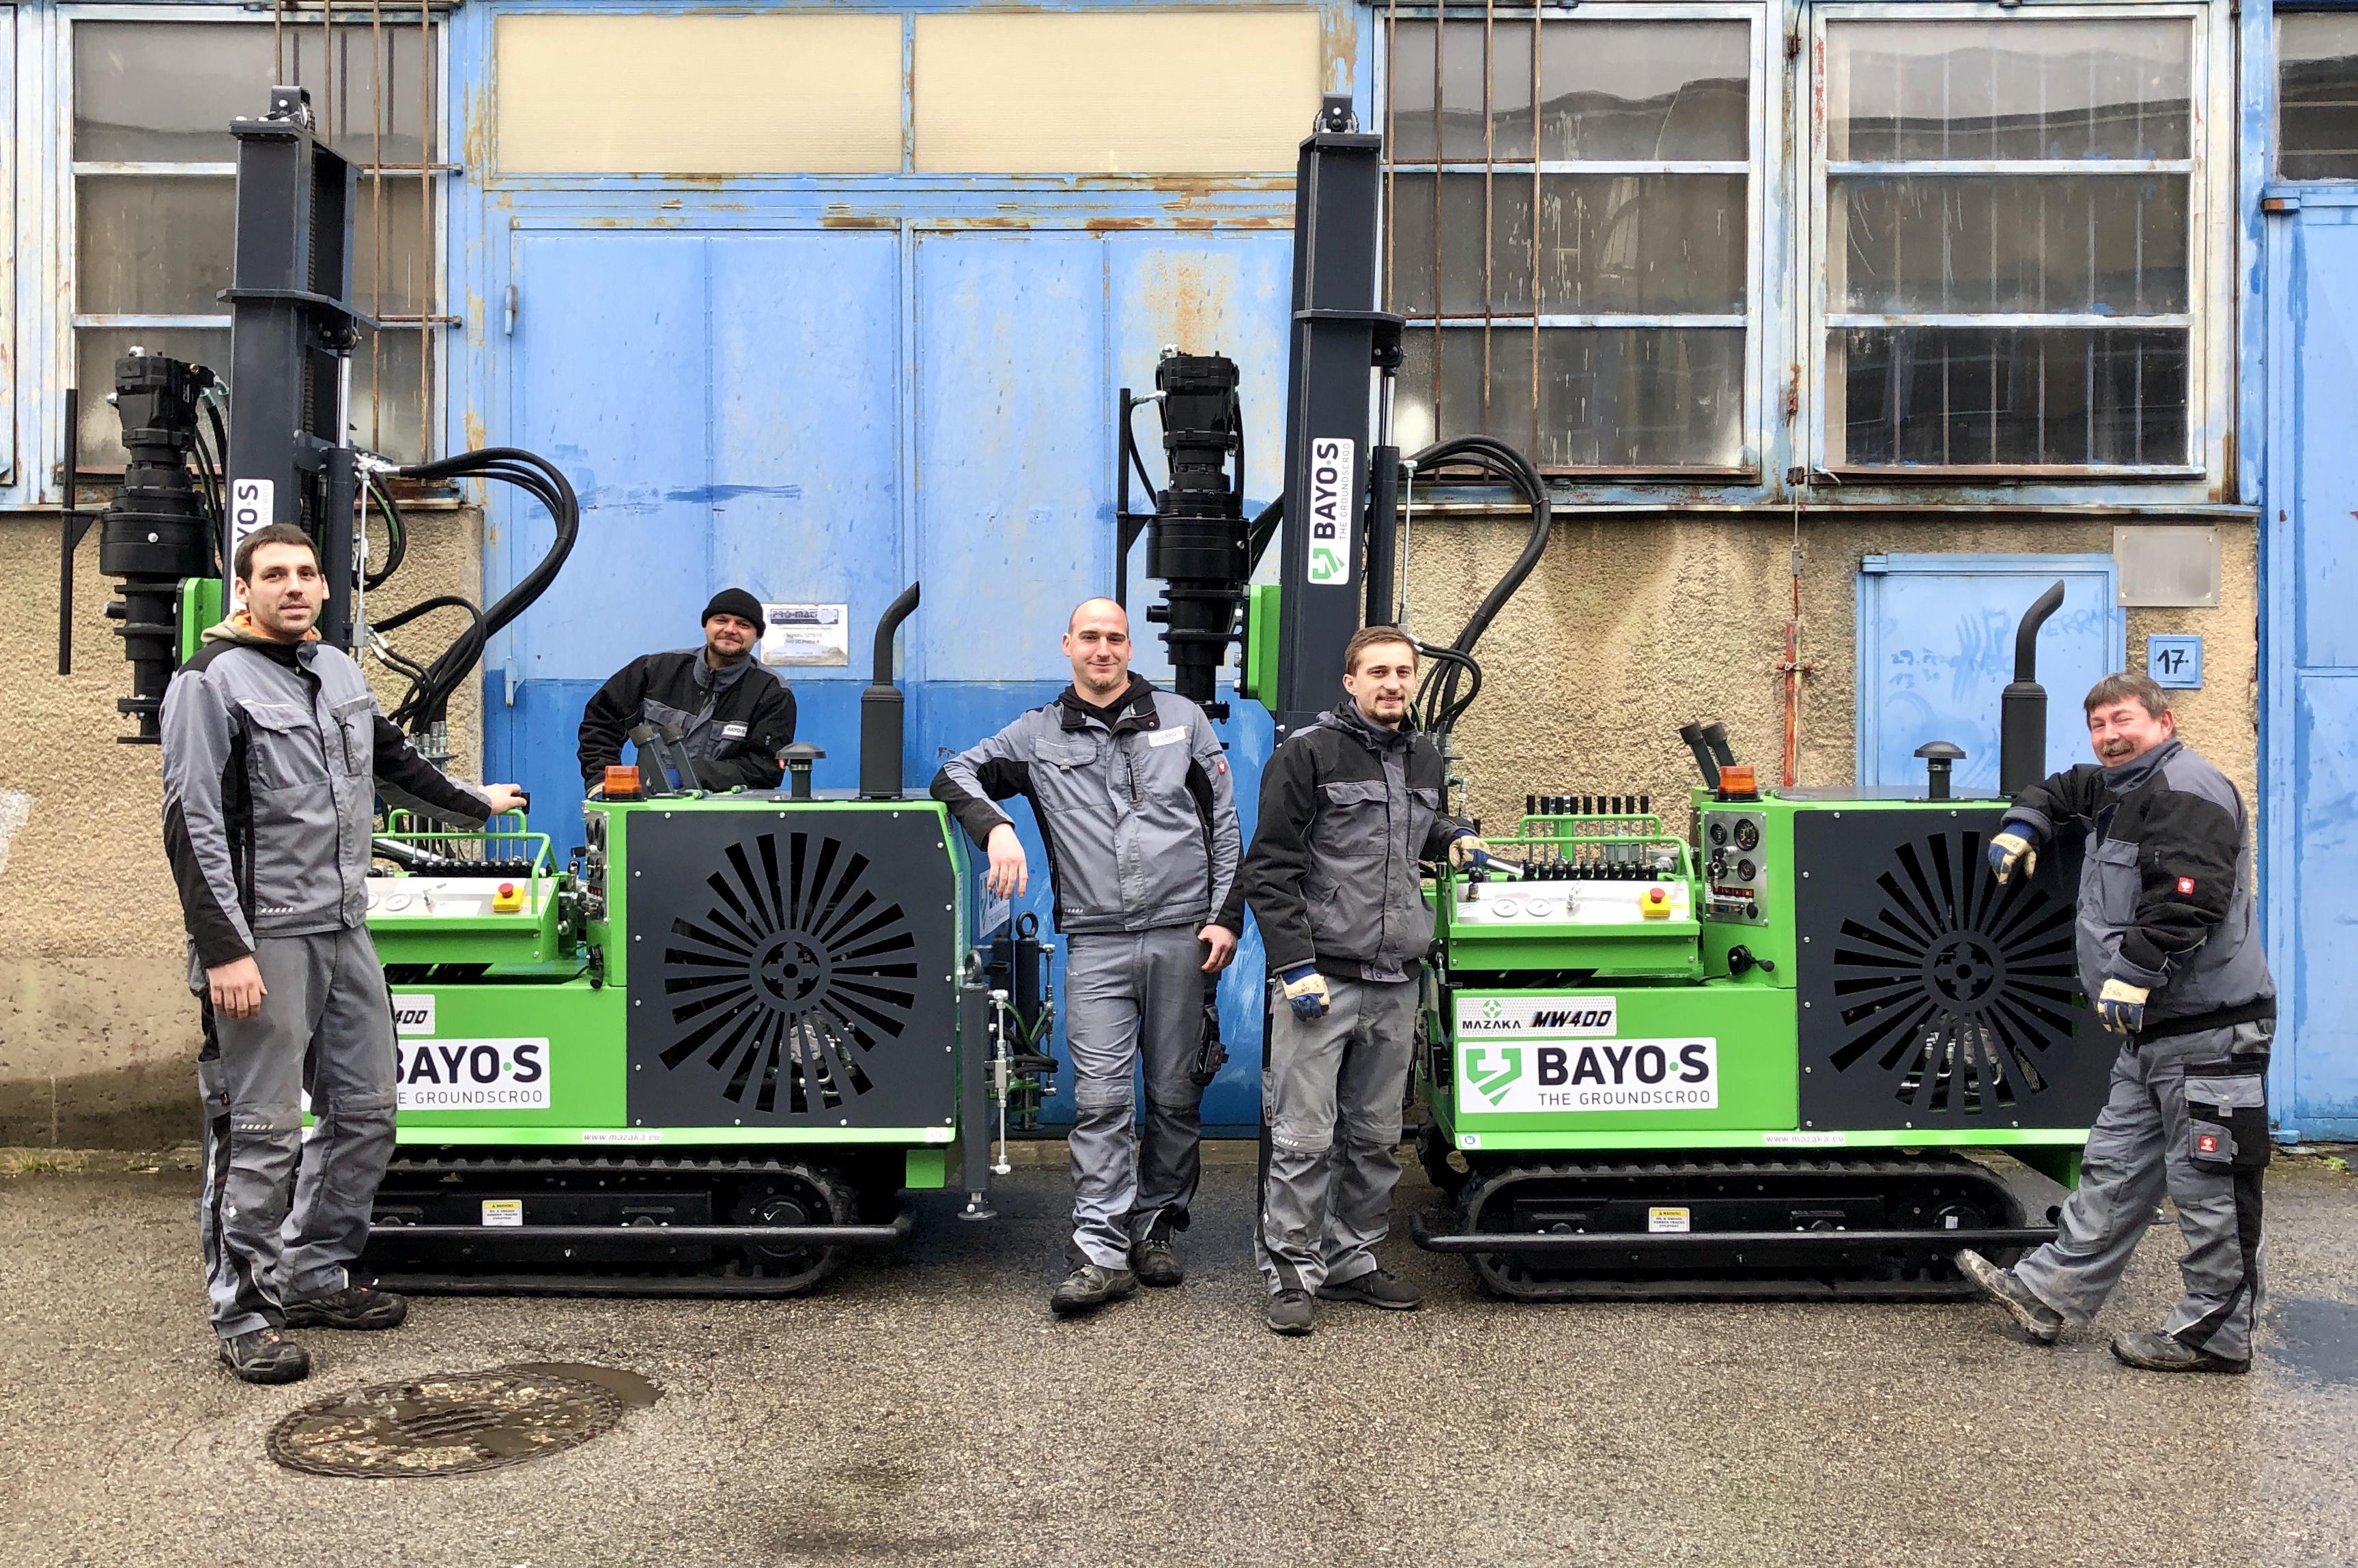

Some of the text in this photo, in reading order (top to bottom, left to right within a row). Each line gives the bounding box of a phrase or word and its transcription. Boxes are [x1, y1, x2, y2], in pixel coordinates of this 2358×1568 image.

[1339, 443, 1350, 540] THE GROUNDSCROO
[1462, 1020, 1522, 1029] MAZAKA
[397, 1044, 542, 1084] AYO·S
[415, 1090, 543, 1104] GROUNDSCROO
[1538, 1090, 1710, 1106] THE GROUNDSCROO
